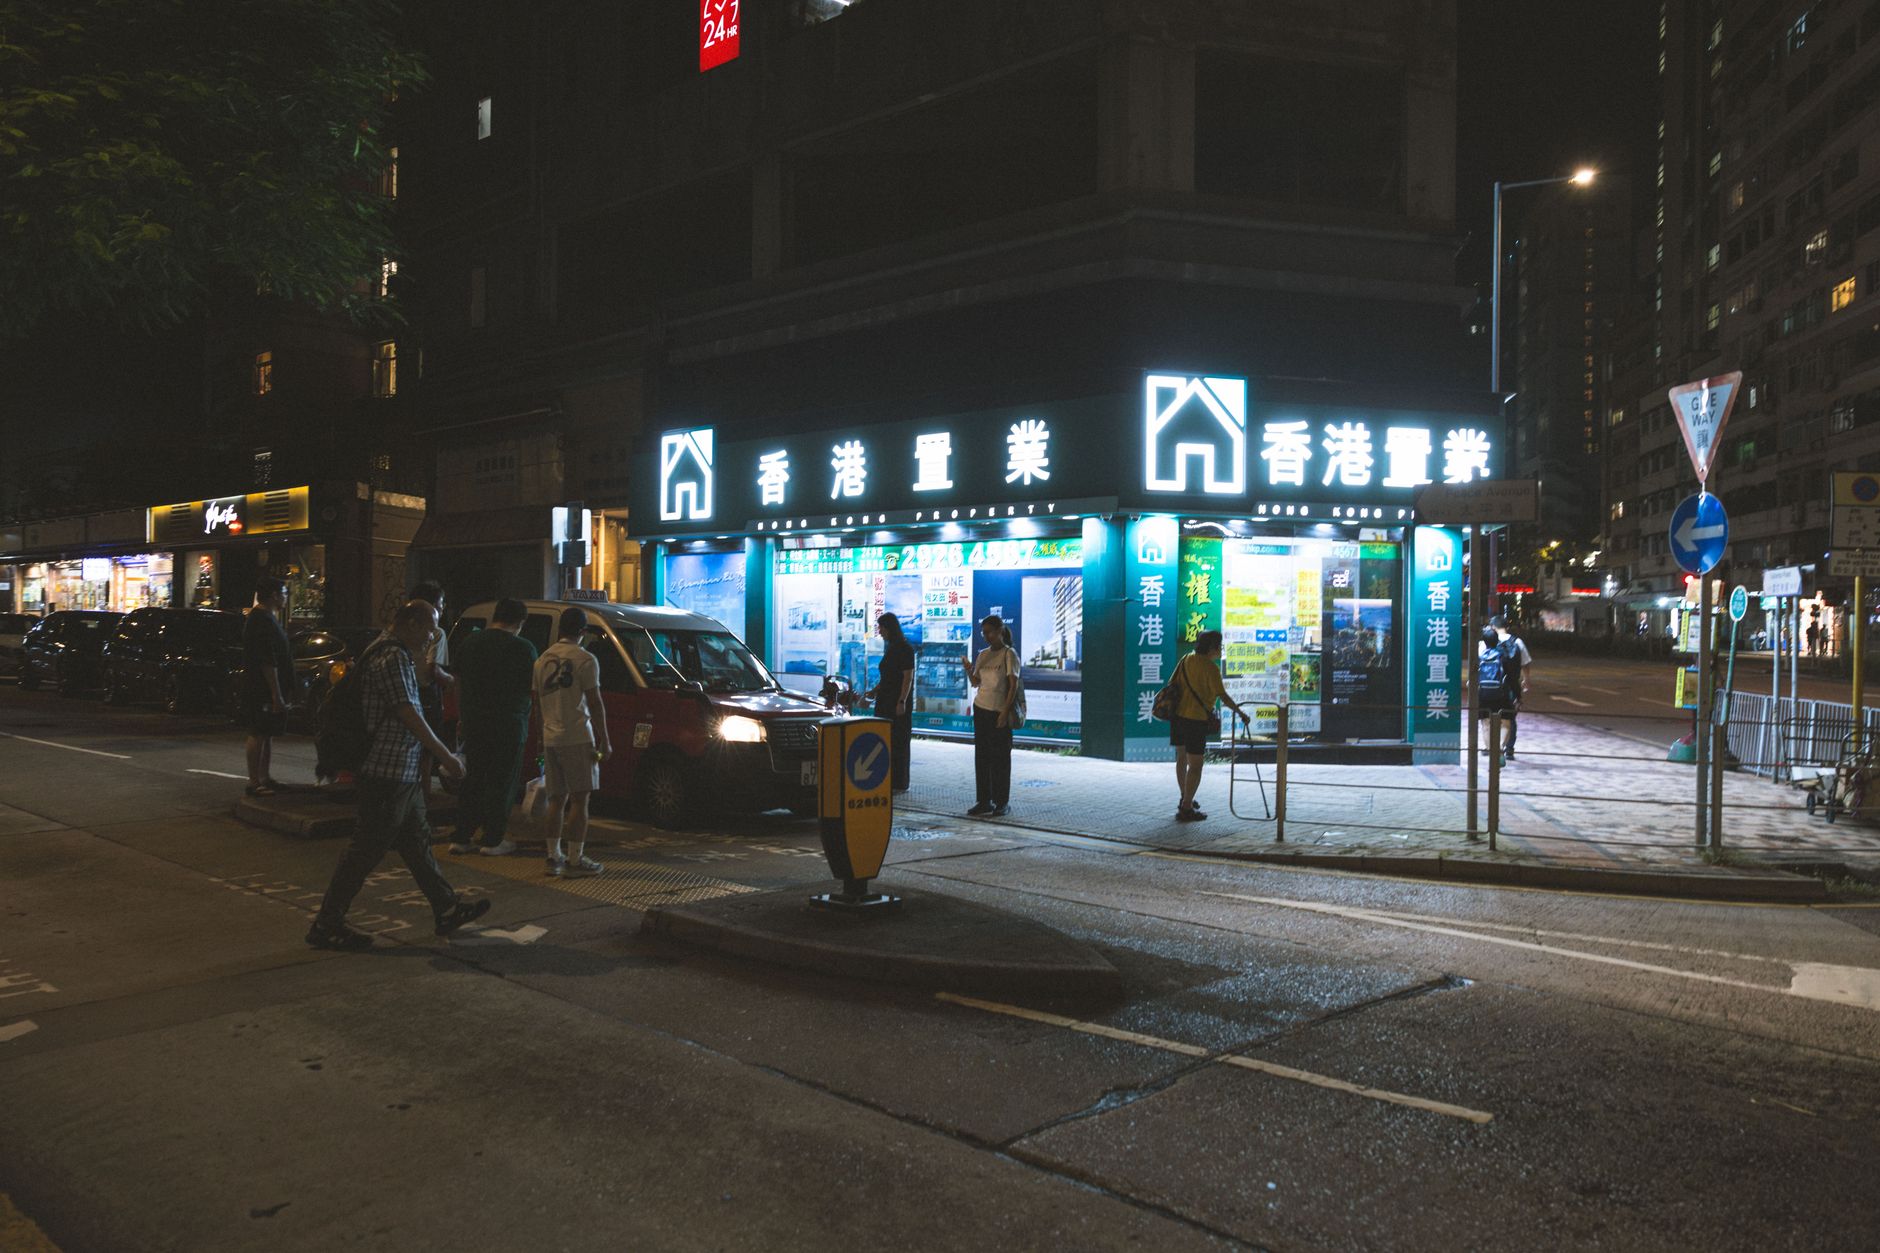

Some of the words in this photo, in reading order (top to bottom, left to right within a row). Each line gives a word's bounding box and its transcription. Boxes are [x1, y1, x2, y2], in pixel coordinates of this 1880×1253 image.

[703, 15, 726, 49] 24
[727, 25, 738, 39] HR
[1691, 393, 1717, 411] GE
[1692, 411, 1715, 427] WAY
[1486, 486, 1531, 497] Avenue
[757, 517, 807, 531] HONG
[830, 513, 886, 528] KONG
[916, 502, 1055, 521] PROPERTY
[1257, 503, 1309, 517] HONG
[1332, 506, 1383, 519] KONG
[943, 575, 965, 588] ONE
[1137, 574, 1165, 724] 香港置業
[1426, 580, 1451, 720] 香港置業
